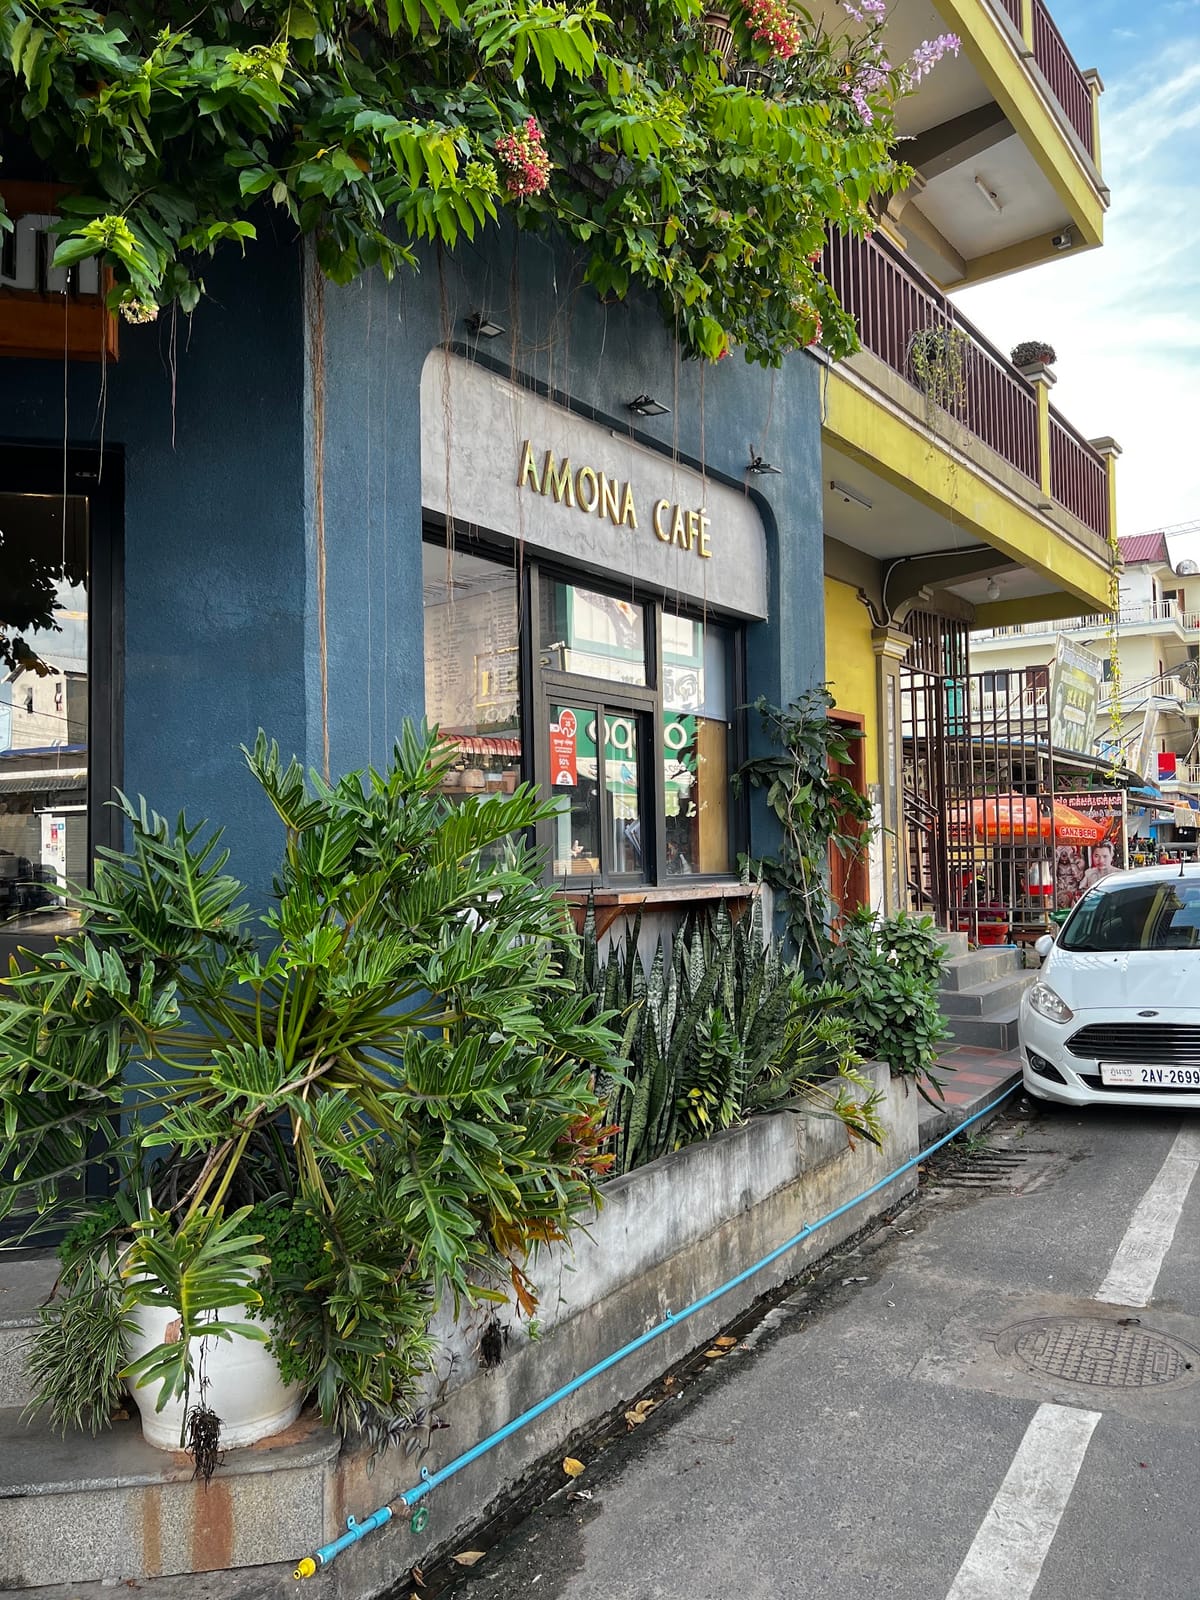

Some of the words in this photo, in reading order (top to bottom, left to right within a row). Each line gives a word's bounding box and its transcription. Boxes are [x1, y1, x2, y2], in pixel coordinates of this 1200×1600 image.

[517, 439, 638, 529] AMONA
[653, 498, 713, 558] CAFÉ
[1060, 827, 1097, 839] GANZBERG
[1141, 1069, 1200, 1084] 2AV-2699
